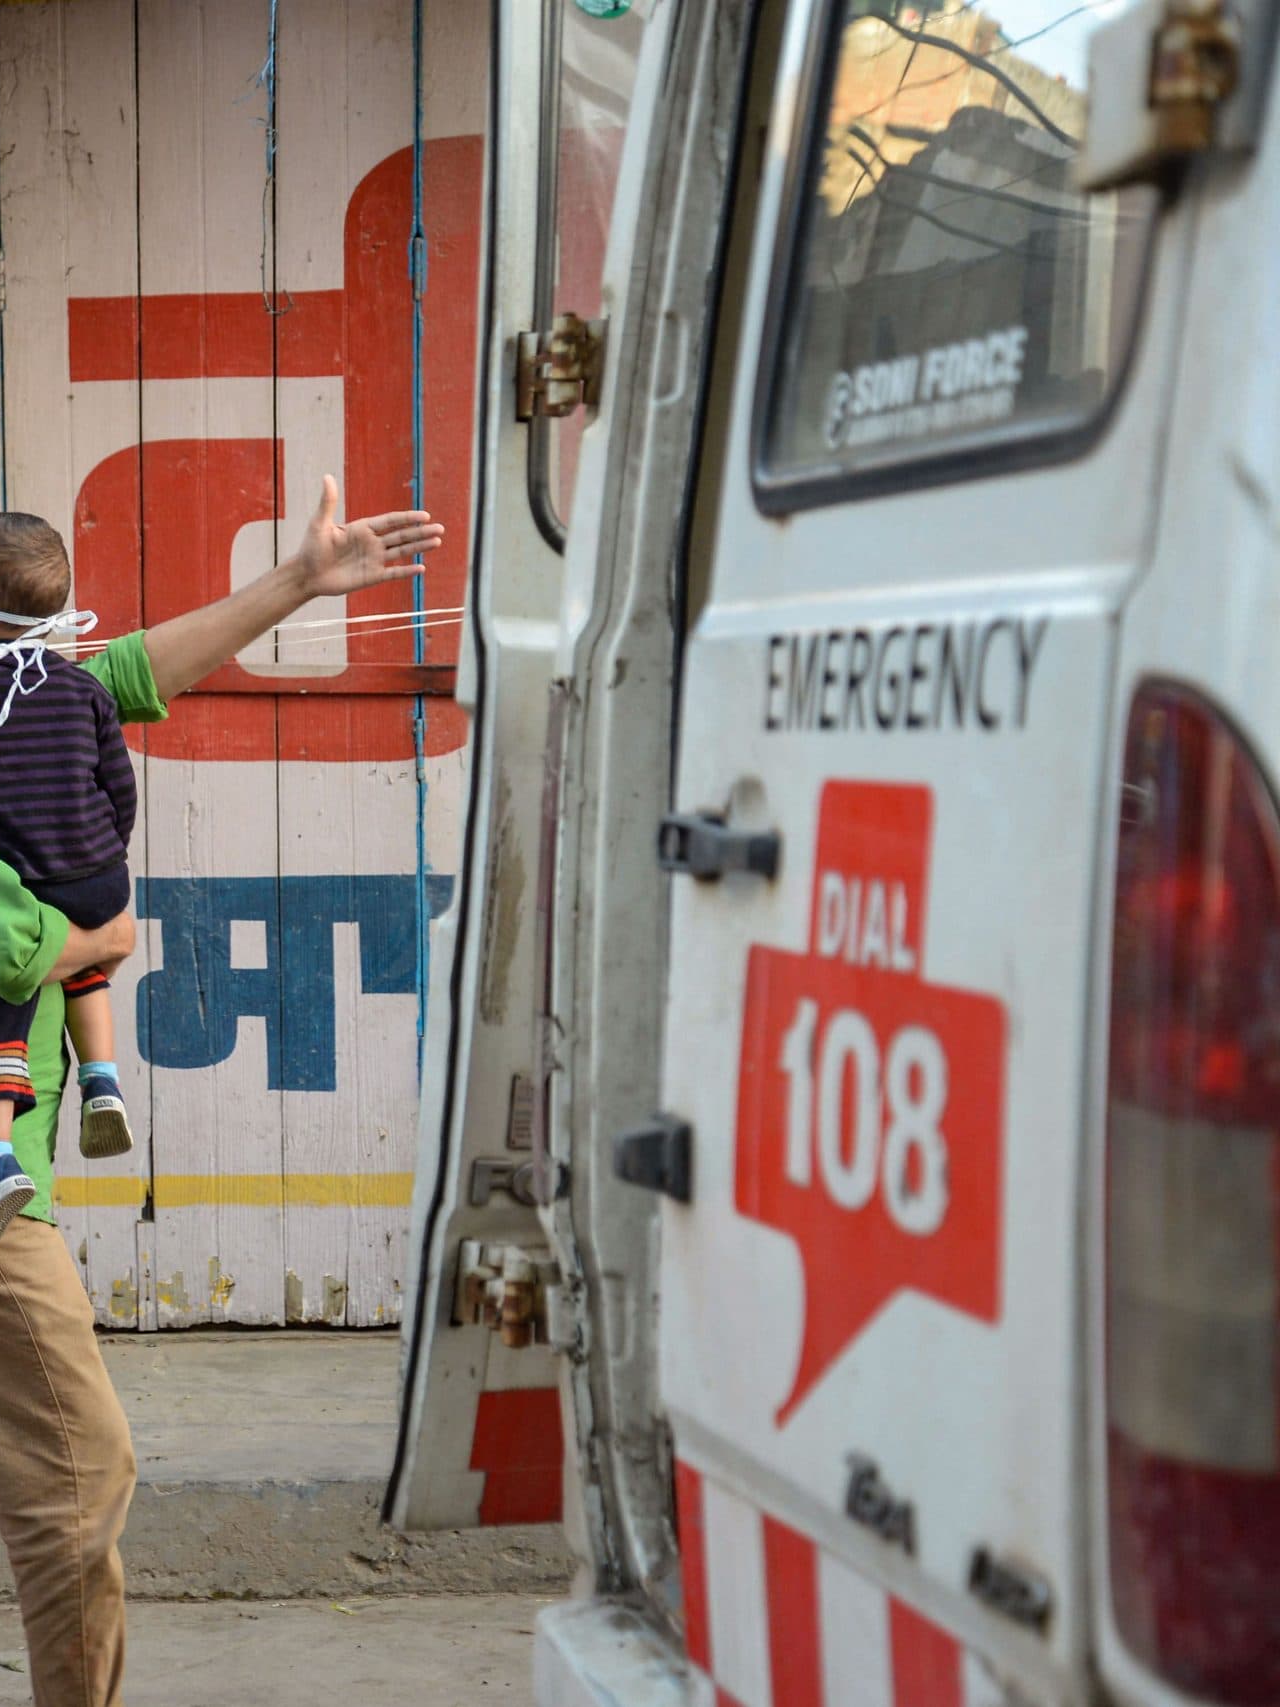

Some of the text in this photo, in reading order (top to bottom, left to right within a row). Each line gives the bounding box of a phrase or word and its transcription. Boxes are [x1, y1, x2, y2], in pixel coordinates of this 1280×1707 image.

[764, 616, 1050, 732] EMERGENCY
[818, 870, 917, 973] DIAL
[778, 997, 950, 1238] 108
